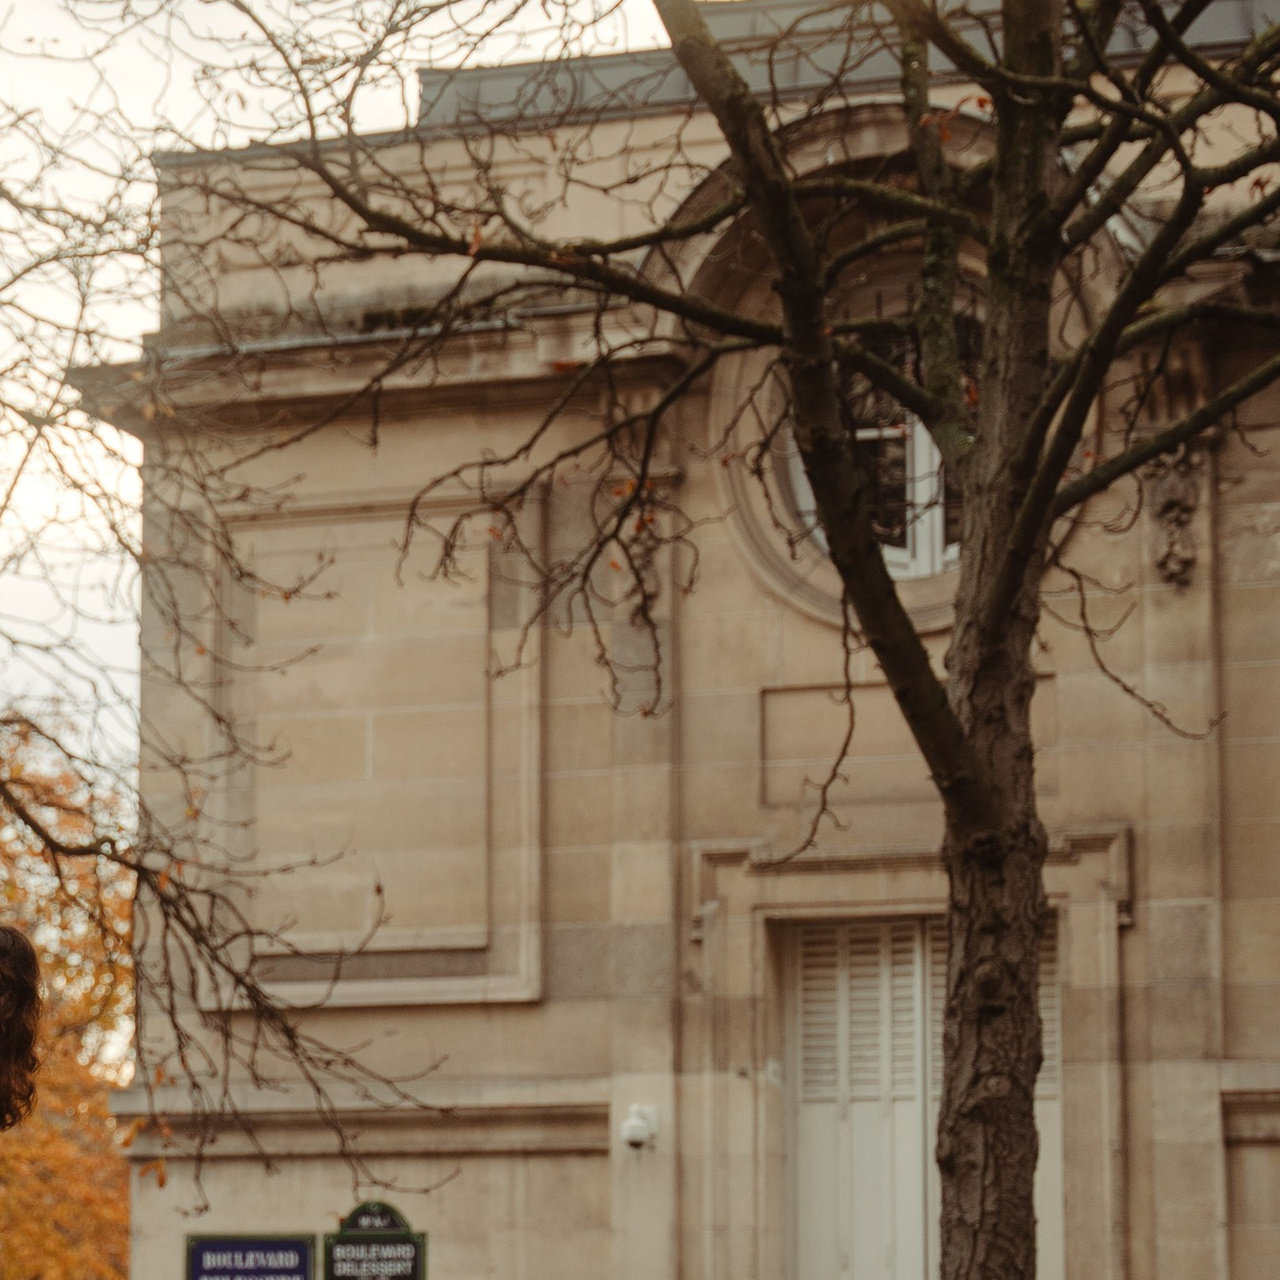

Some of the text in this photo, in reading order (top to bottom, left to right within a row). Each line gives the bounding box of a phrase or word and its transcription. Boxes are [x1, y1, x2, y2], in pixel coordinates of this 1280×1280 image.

[202, 1250, 299, 1270] BOULEVARD
[332, 1244, 415, 1260] BOULEVARD
[334, 1260, 414, 1276] DELESSERT
